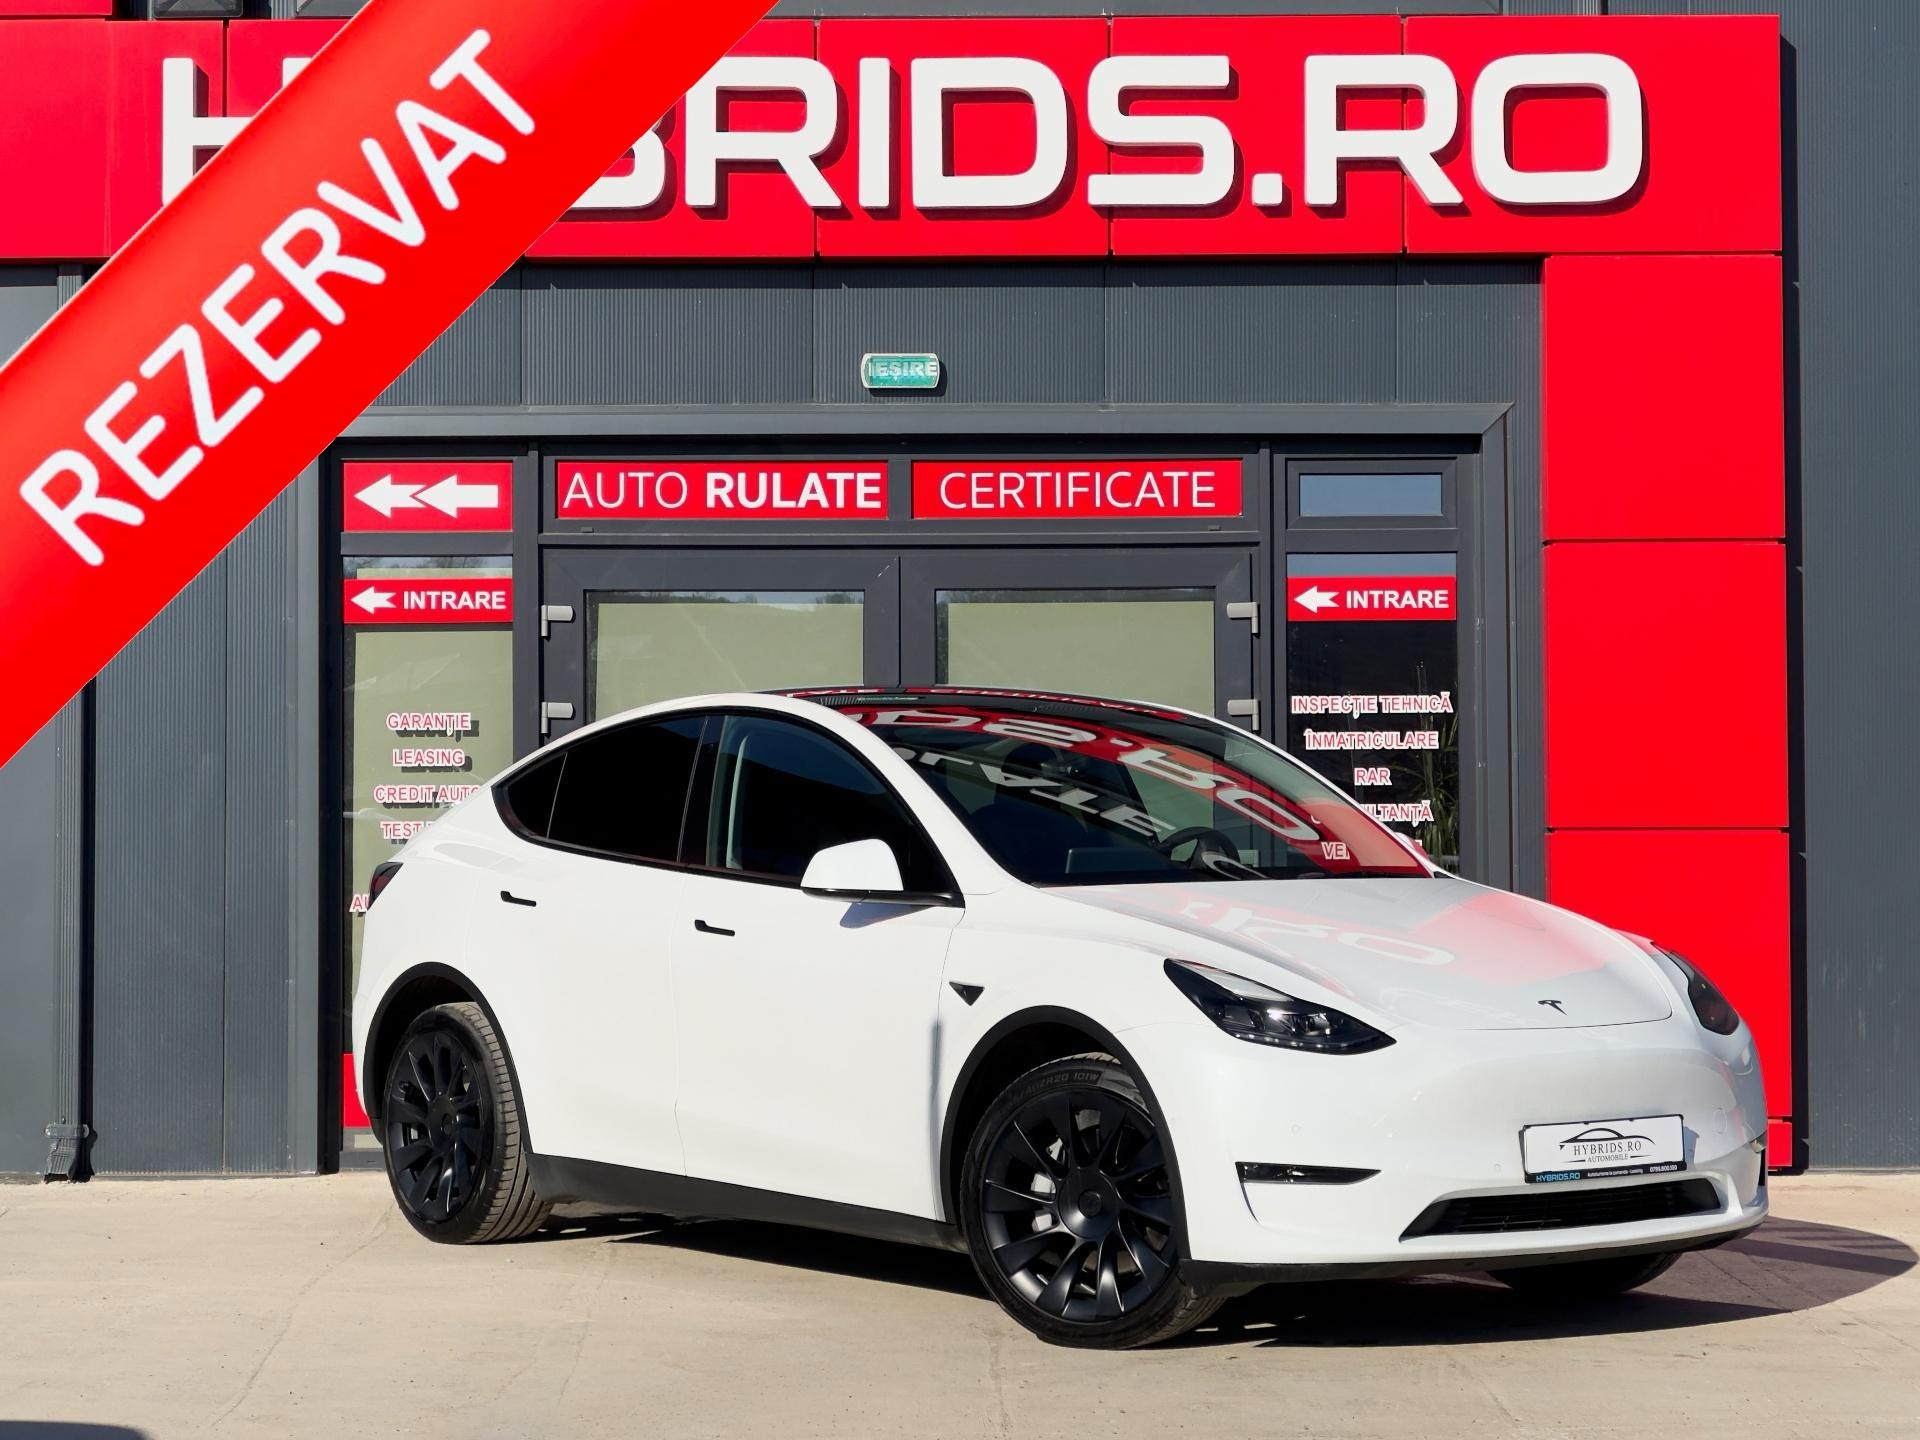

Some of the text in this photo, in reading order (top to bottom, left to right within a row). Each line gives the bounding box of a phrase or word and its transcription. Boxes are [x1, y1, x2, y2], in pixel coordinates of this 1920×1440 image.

[563, 472, 881, 508] AUTO RULATE
[940, 472, 1216, 508] CERTIFICATE
[403, 591, 506, 610] INTRARE
[1346, 590, 1449, 609] INTRARE
[1291, 692, 1453, 719] INSPECȚIE TEHNICĂ
[387, 712, 471, 736] GARANȚIE
[1304, 729, 1439, 750] ÎNMATRICULARE
[393, 749, 465, 767] LEASING
[1354, 768, 1391, 785] RAR
[374, 784, 435, 804] CREDIT
[380, 820, 422, 840] TEST
[1573, 1140, 1642, 1156] HYBRIDS.RO
[1587, 1153, 1629, 1163] AUTOMOBILE
[1536, 1172, 1581, 1183] HYBRIDS.RO
